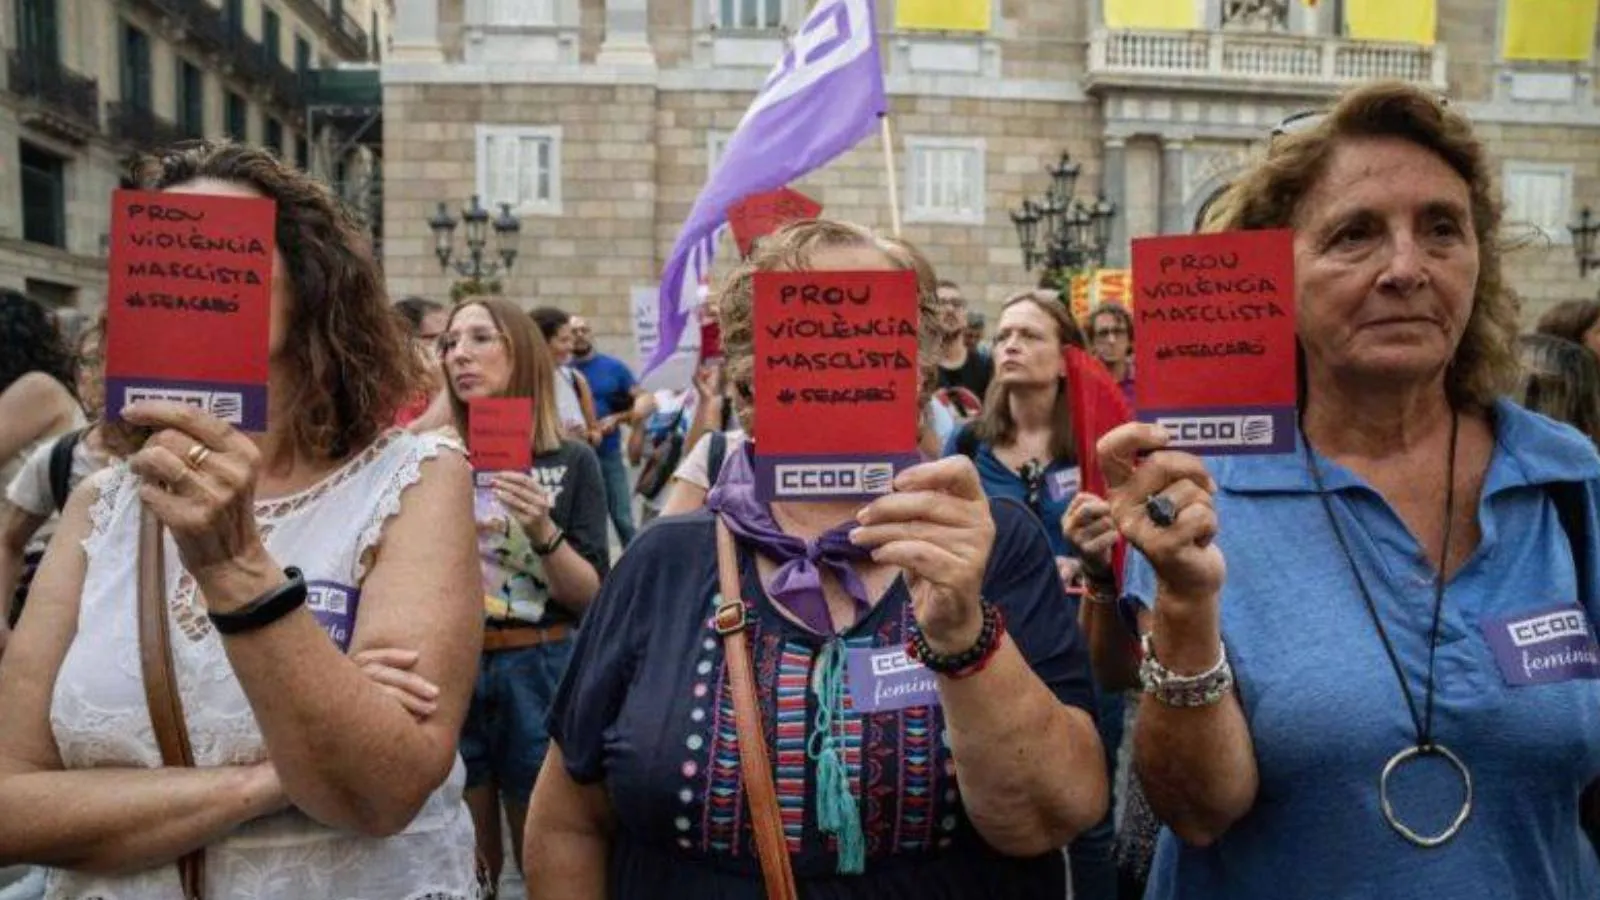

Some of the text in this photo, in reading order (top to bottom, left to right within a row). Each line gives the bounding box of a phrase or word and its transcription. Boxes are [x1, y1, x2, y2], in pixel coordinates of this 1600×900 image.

[128, 204, 205, 221] PROU
[1160, 252, 1239, 273] PROU
[780, 284, 871, 306] PROU
[782, 470, 855, 488] CCOO
[1514, 614, 1581, 640] CCOO
